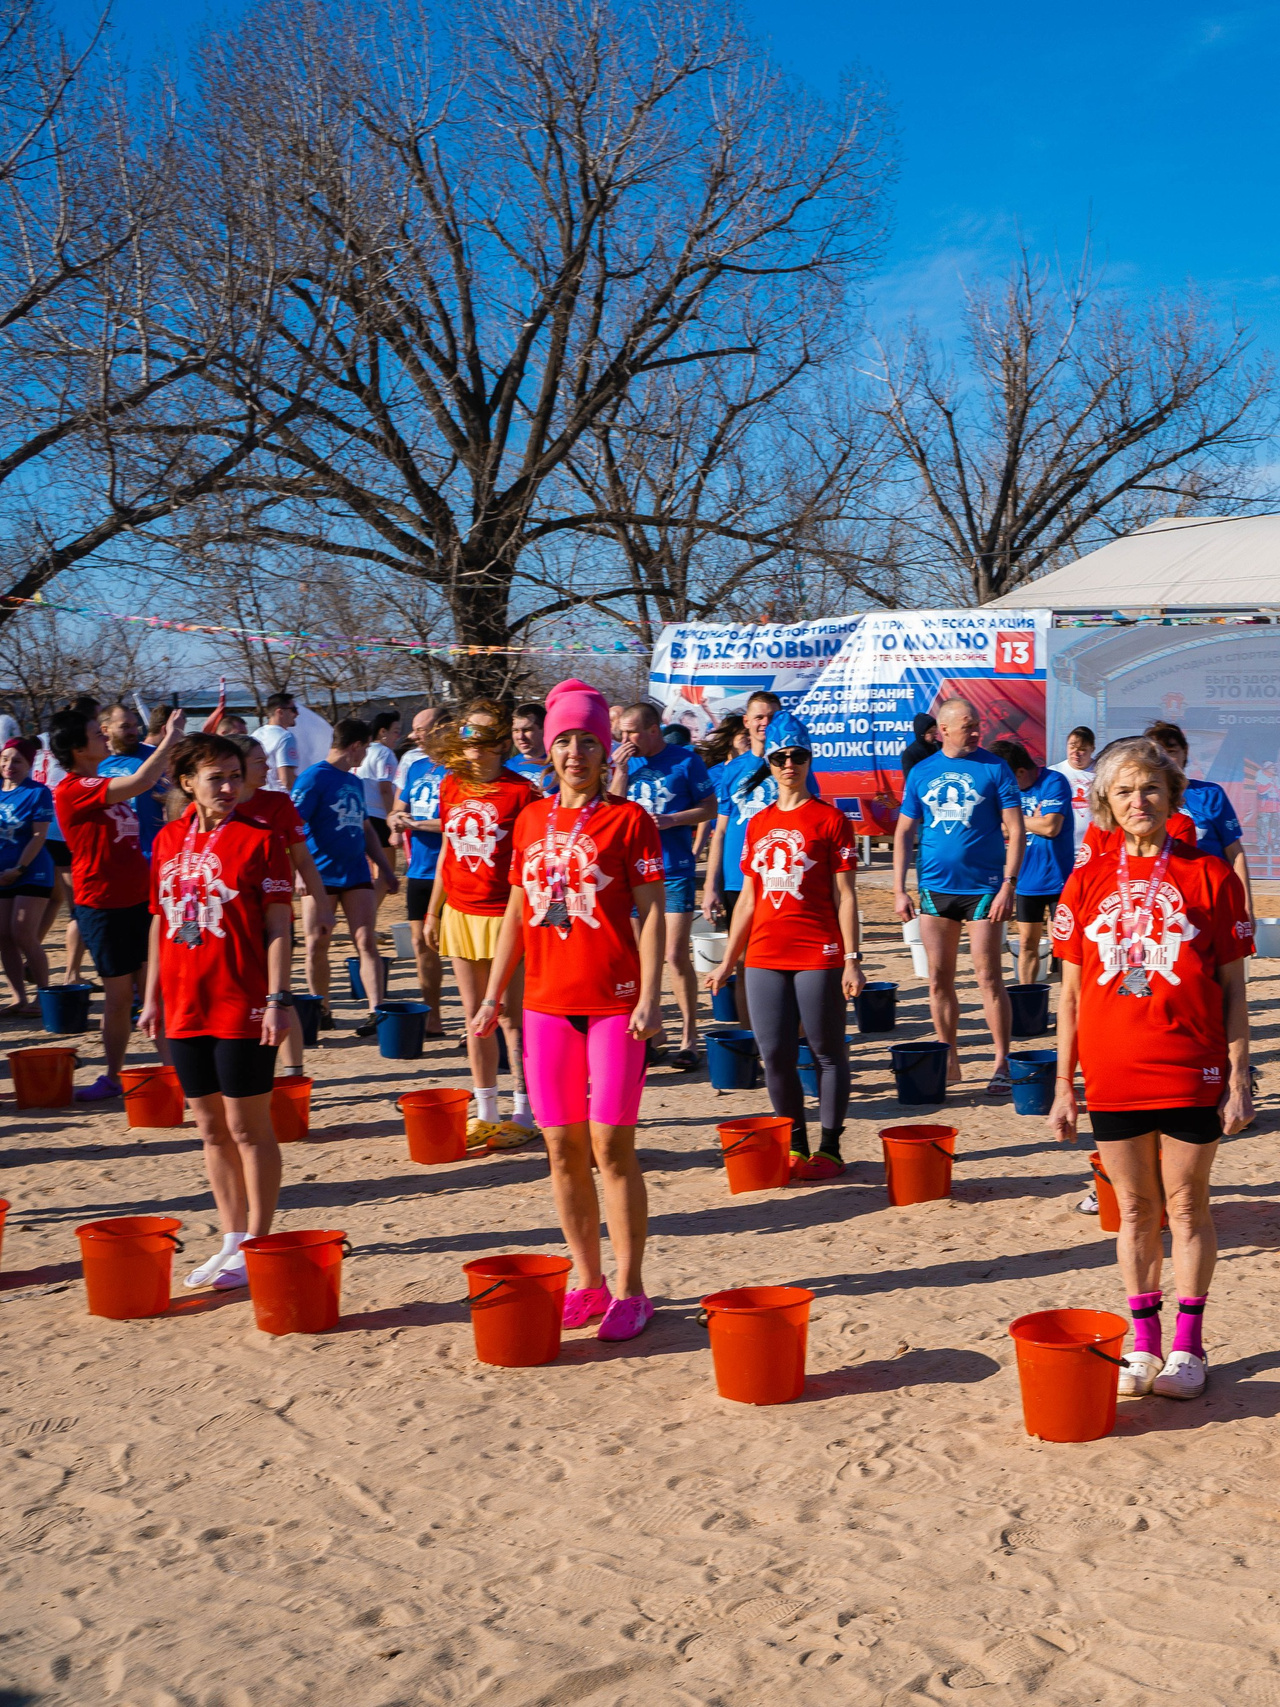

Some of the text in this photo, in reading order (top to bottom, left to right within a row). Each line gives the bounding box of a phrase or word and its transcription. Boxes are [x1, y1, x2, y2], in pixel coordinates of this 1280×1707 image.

[988, 618, 1035, 629] АКЦИЯ
[713, 638, 843, 659] ЗДОРОВЫМ
[1000, 640, 1030, 665] 13
[770, 658, 816, 669] ПОБЕДЫ
[954, 651, 988, 662] ВОЙНЕ
[1120, 655, 1223, 695] МЕЖДУНАРОДНАЯ
[1205, 674, 1240, 685] БЫТЬ
[833, 688, 915, 703] ОБЛИВАНИЕ
[1205, 685, 1241, 698] ЭТО
[849, 698, 897, 713] ВОДОЙ
[847, 718, 869, 735] 10
[870, 720, 915, 733] СТРАН
[1218, 714, 1237, 725] 50
[811, 737, 908, 759] ВОЛЖСКИЙ
